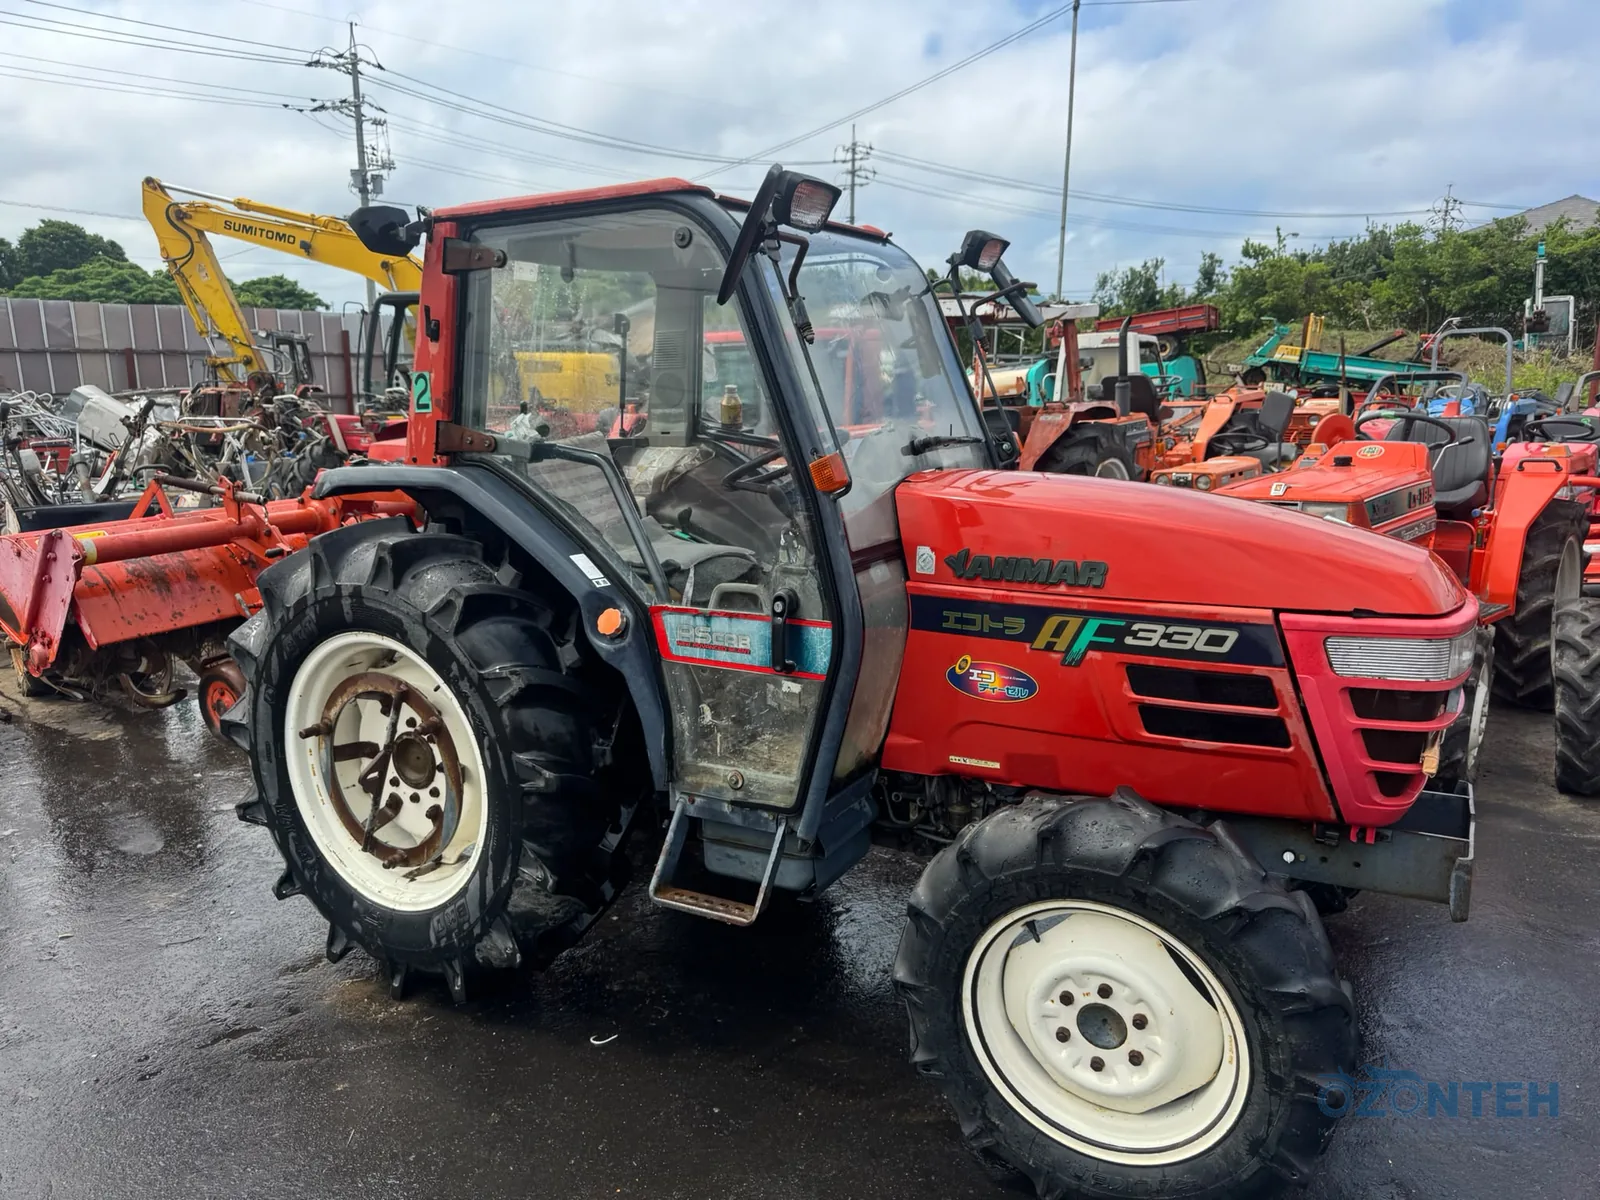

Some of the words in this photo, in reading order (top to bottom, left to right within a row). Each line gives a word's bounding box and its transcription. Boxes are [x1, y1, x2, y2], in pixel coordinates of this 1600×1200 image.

[223, 219, 296, 245] SUMITOMO
[414, 372, 430, 410] 2
[944, 548, 1109, 589] YANMAR
[942, 610, 1026, 635] エコトラ
[968, 668, 996, 683] エコ
[978, 682, 1029, 699] ディーゼル
